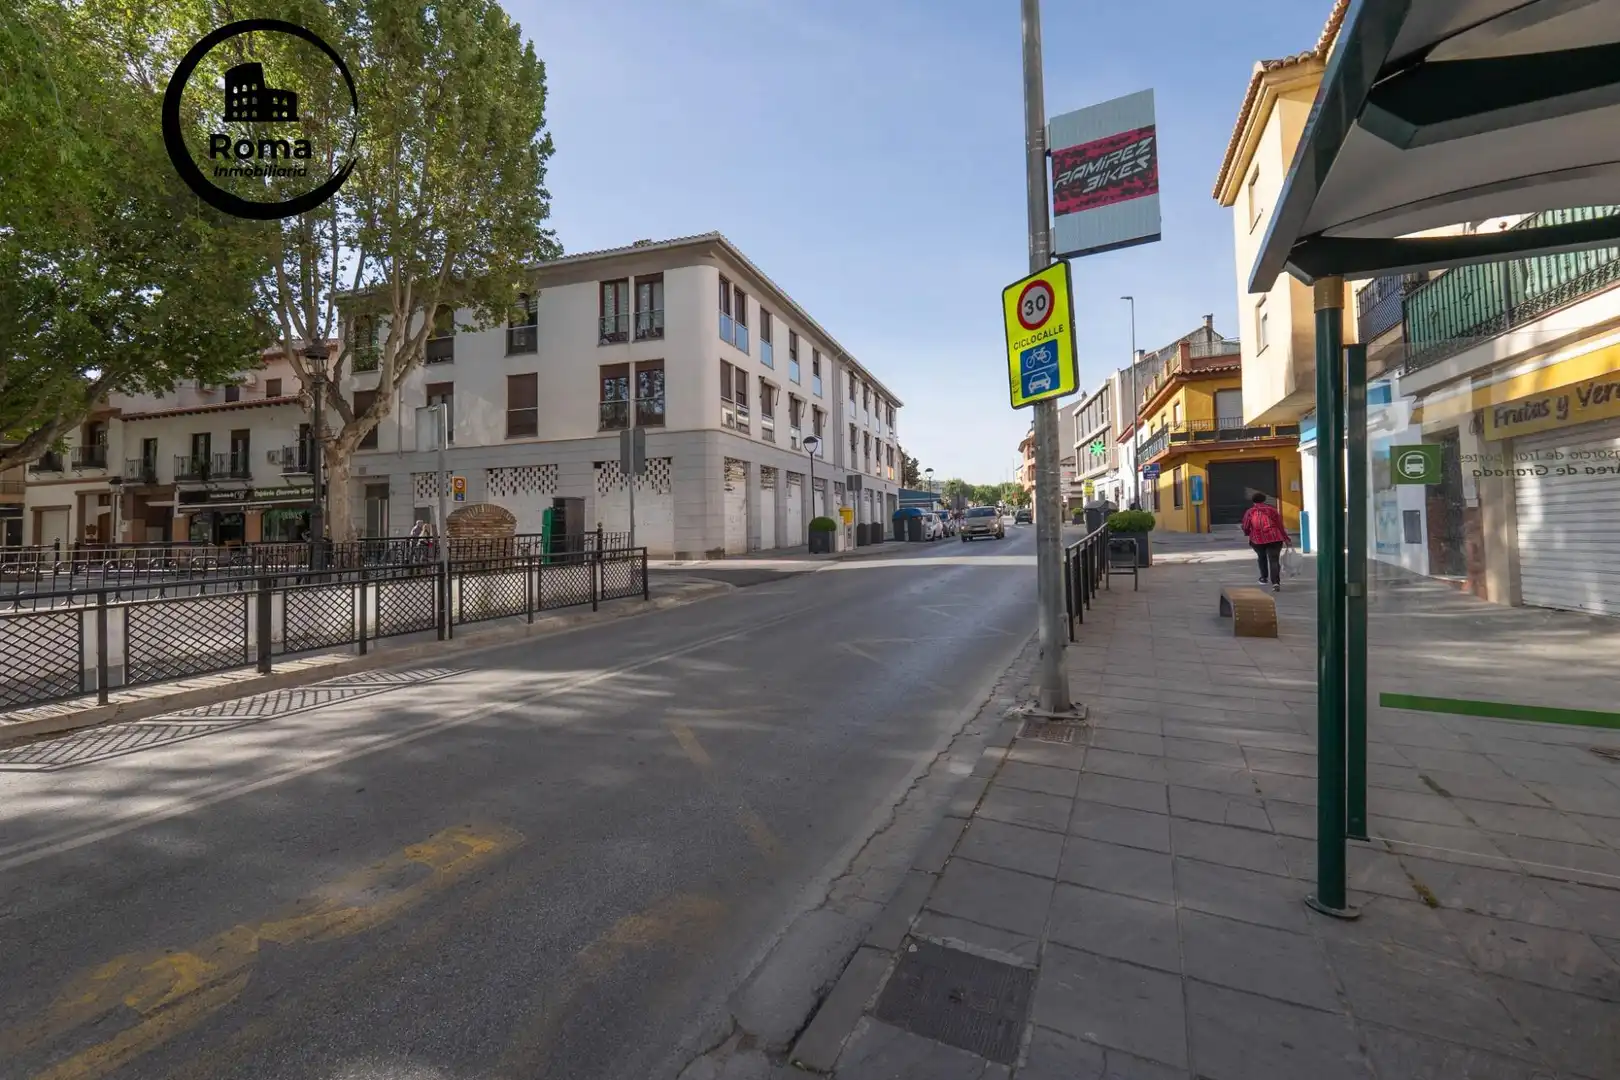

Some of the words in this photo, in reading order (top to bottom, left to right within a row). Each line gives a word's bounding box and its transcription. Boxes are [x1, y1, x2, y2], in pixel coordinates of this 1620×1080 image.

[1024, 294, 1046, 316] 30
[1013, 324, 1064, 350] CICLOCALLE
[1493, 398, 1550, 428] Frutas
[1556, 394, 1569, 420] y
